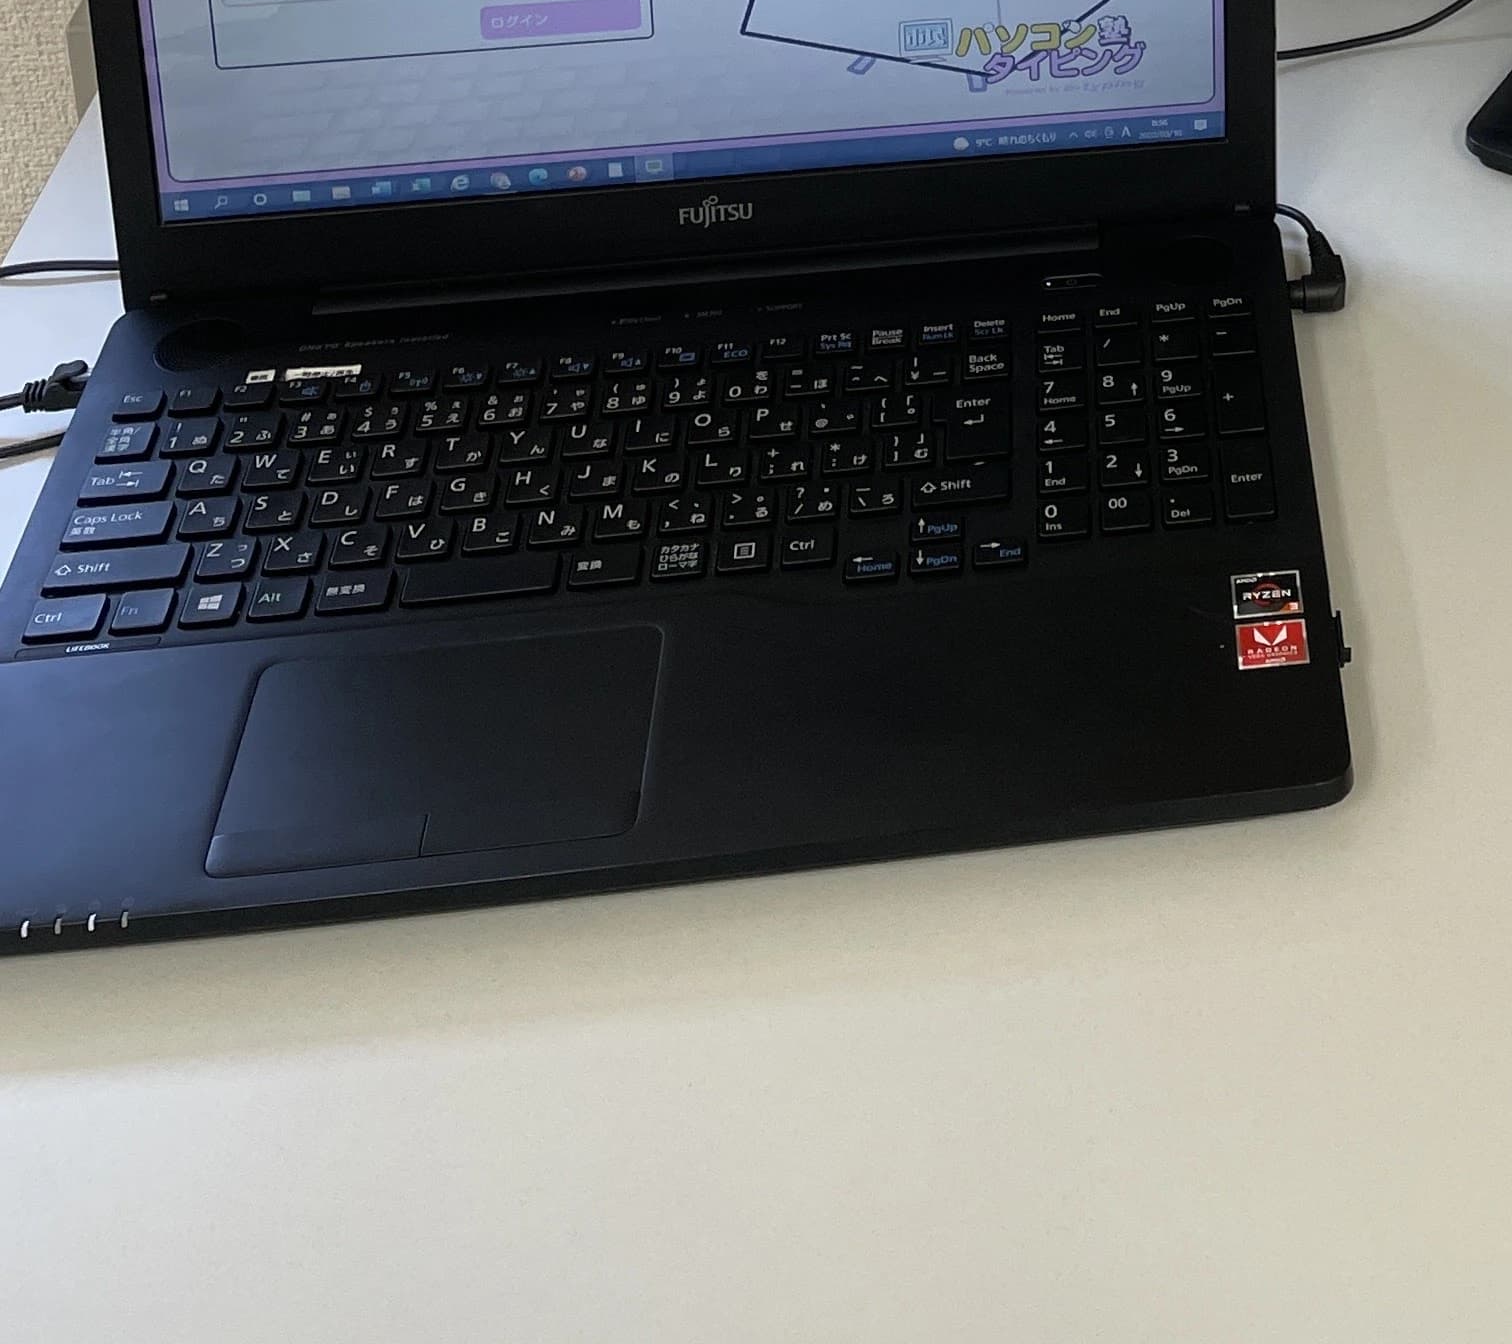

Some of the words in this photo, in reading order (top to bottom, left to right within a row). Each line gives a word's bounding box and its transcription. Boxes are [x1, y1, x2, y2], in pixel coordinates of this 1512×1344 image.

[983, 40, 1147, 85] タイピング
[678, 194, 754, 229] FUJITSU
[1242, 589, 1292, 601] RYZEN
